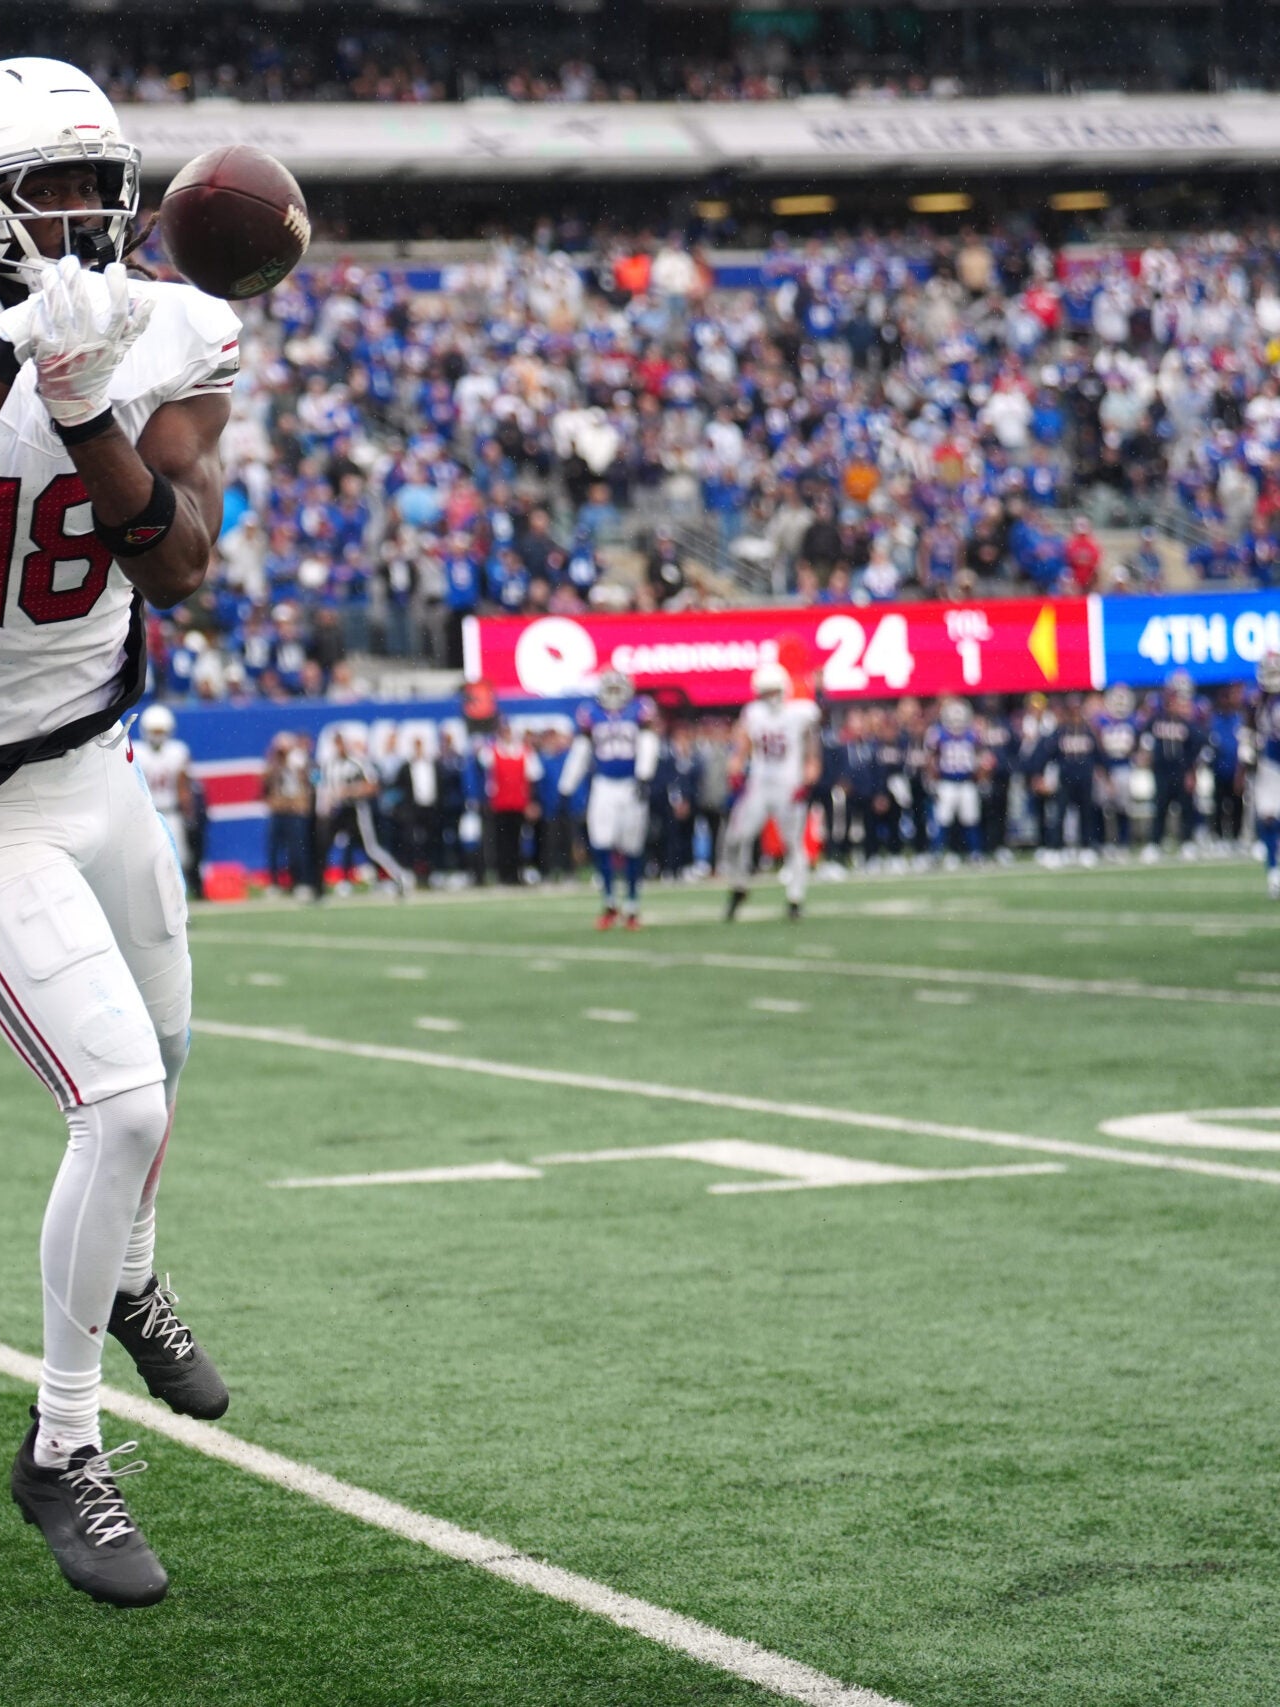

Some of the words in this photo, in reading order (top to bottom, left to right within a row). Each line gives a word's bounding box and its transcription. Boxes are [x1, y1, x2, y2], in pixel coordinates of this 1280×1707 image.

[1024, 112, 1234, 149] STADIUM
[612, 640, 779, 675] CARDINALS
[816, 614, 915, 692] 24
[956, 629, 983, 686] 1
[1138, 613, 1228, 665] 4TH
